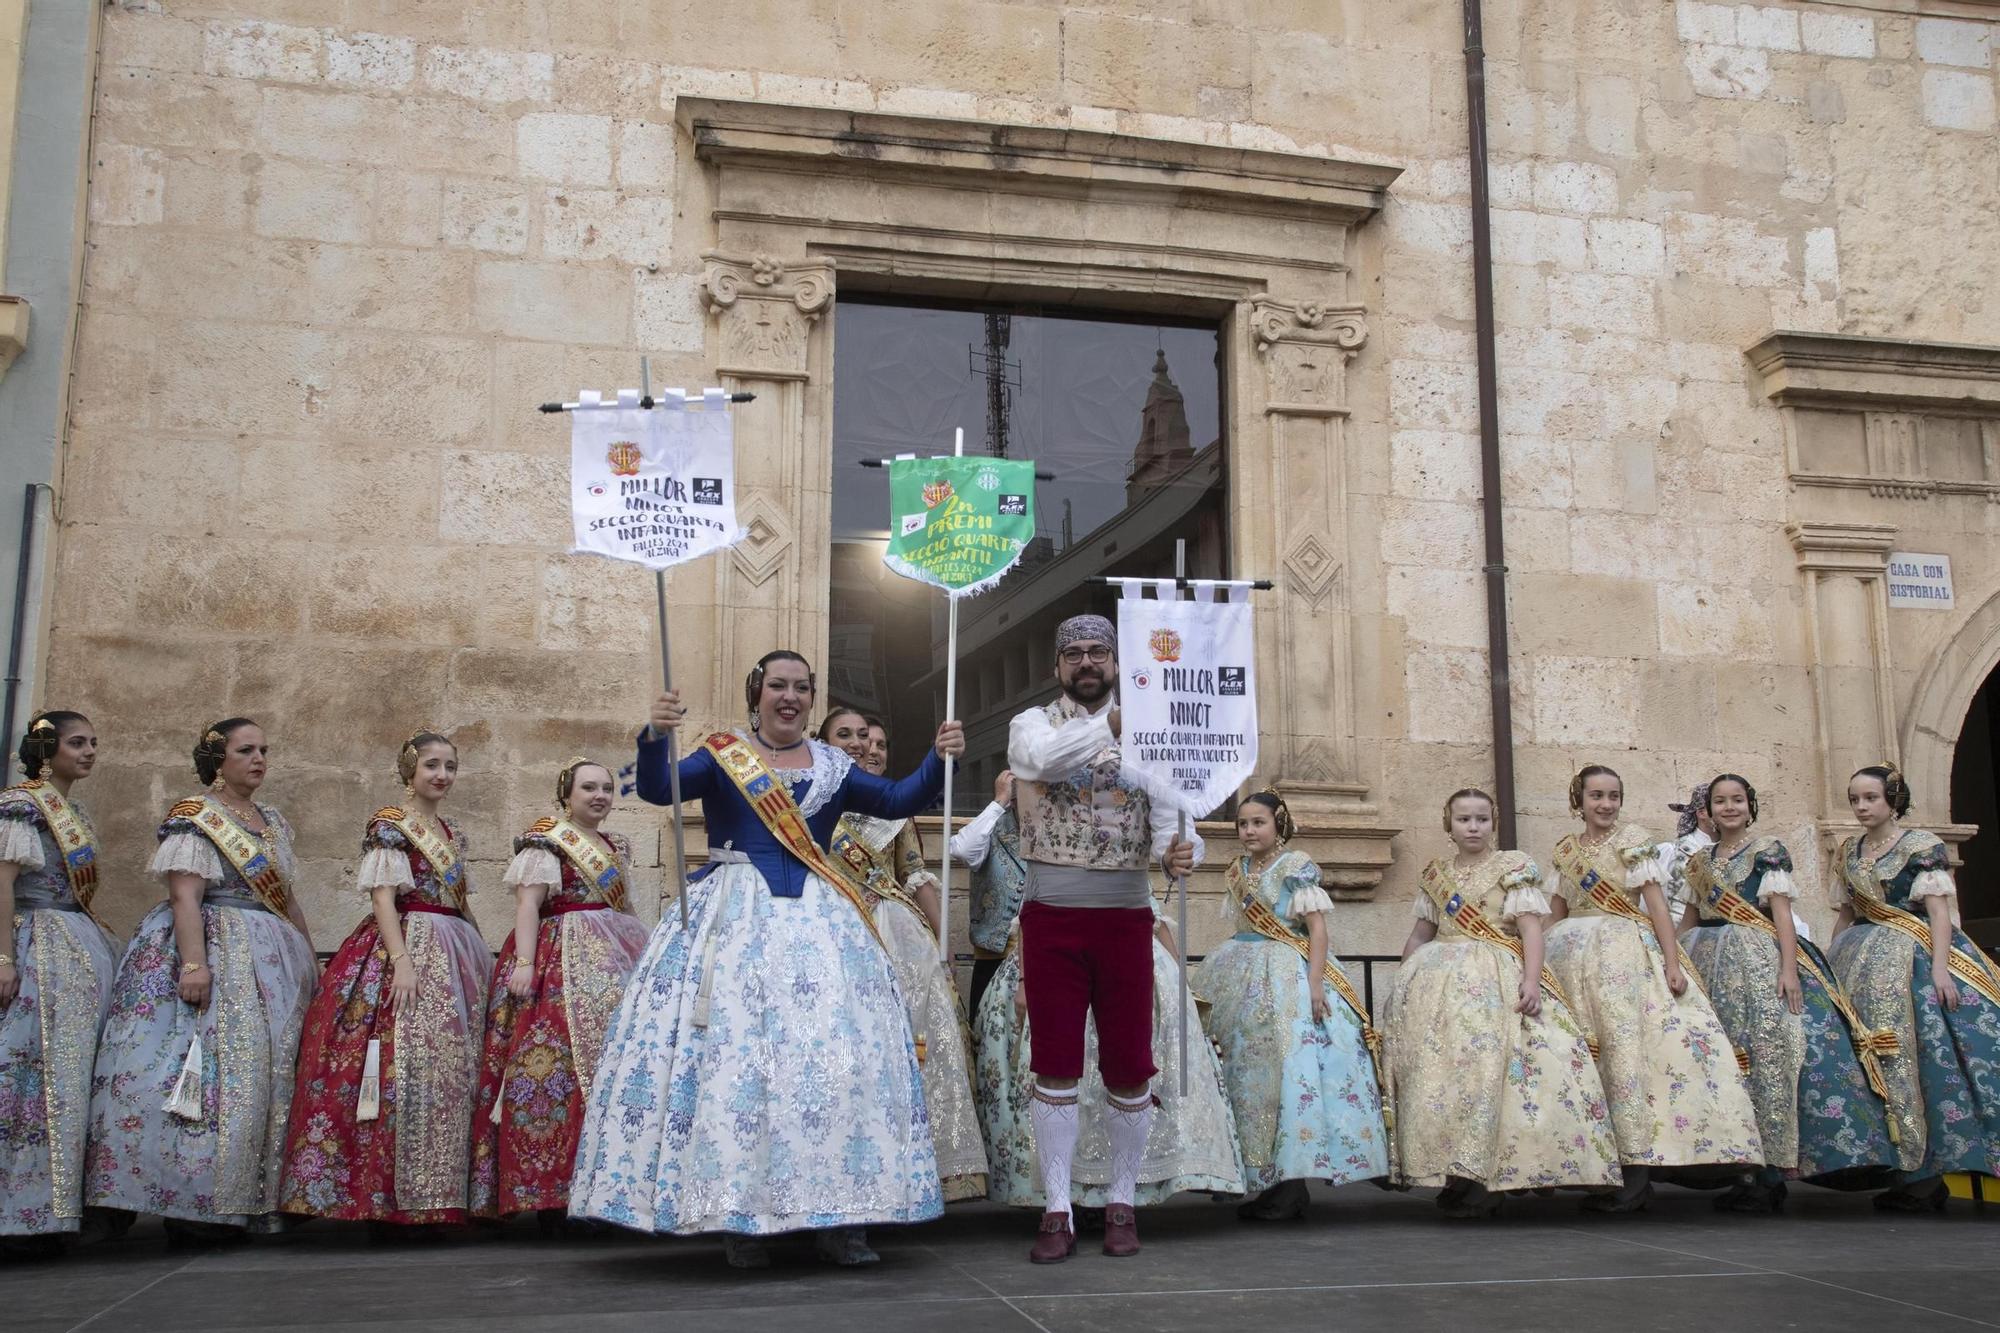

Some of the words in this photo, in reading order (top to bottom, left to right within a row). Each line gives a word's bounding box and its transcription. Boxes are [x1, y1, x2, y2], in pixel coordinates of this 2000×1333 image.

[621, 477, 688, 503] MILLOR
[589, 512, 648, 532] SECCIÓ
[653, 513, 725, 532] QUARTA
[928, 515, 992, 538] PREMI
[618, 525, 698, 541] INFANTIL
[633, 538, 664, 552] FALLES
[667, 539, 688, 550] 2024
[645, 547, 680, 558] ALZIRA
[1891, 563, 1920, 577] CASA
[1923, 565, 1944, 578] CON
[1890, 584, 1950, 600] SISTORIAL
[1163, 667, 1215, 696] MILLOR
[1220, 680, 1243, 688] FLEX
[1170, 701, 1211, 729] NINOT
[1133, 728, 1168, 745] SECCIÓ
[1170, 731, 1202, 746] QUARTA
[1203, 734, 1246, 747] INFANTIL
[1140, 748, 1186, 761] VALORAT
[1188, 749, 1200, 762] PER
[1201, 749, 1239, 763] XIQUETS
[1172, 768, 1197, 779] FALLES
[57, 817, 74, 829] 2024
